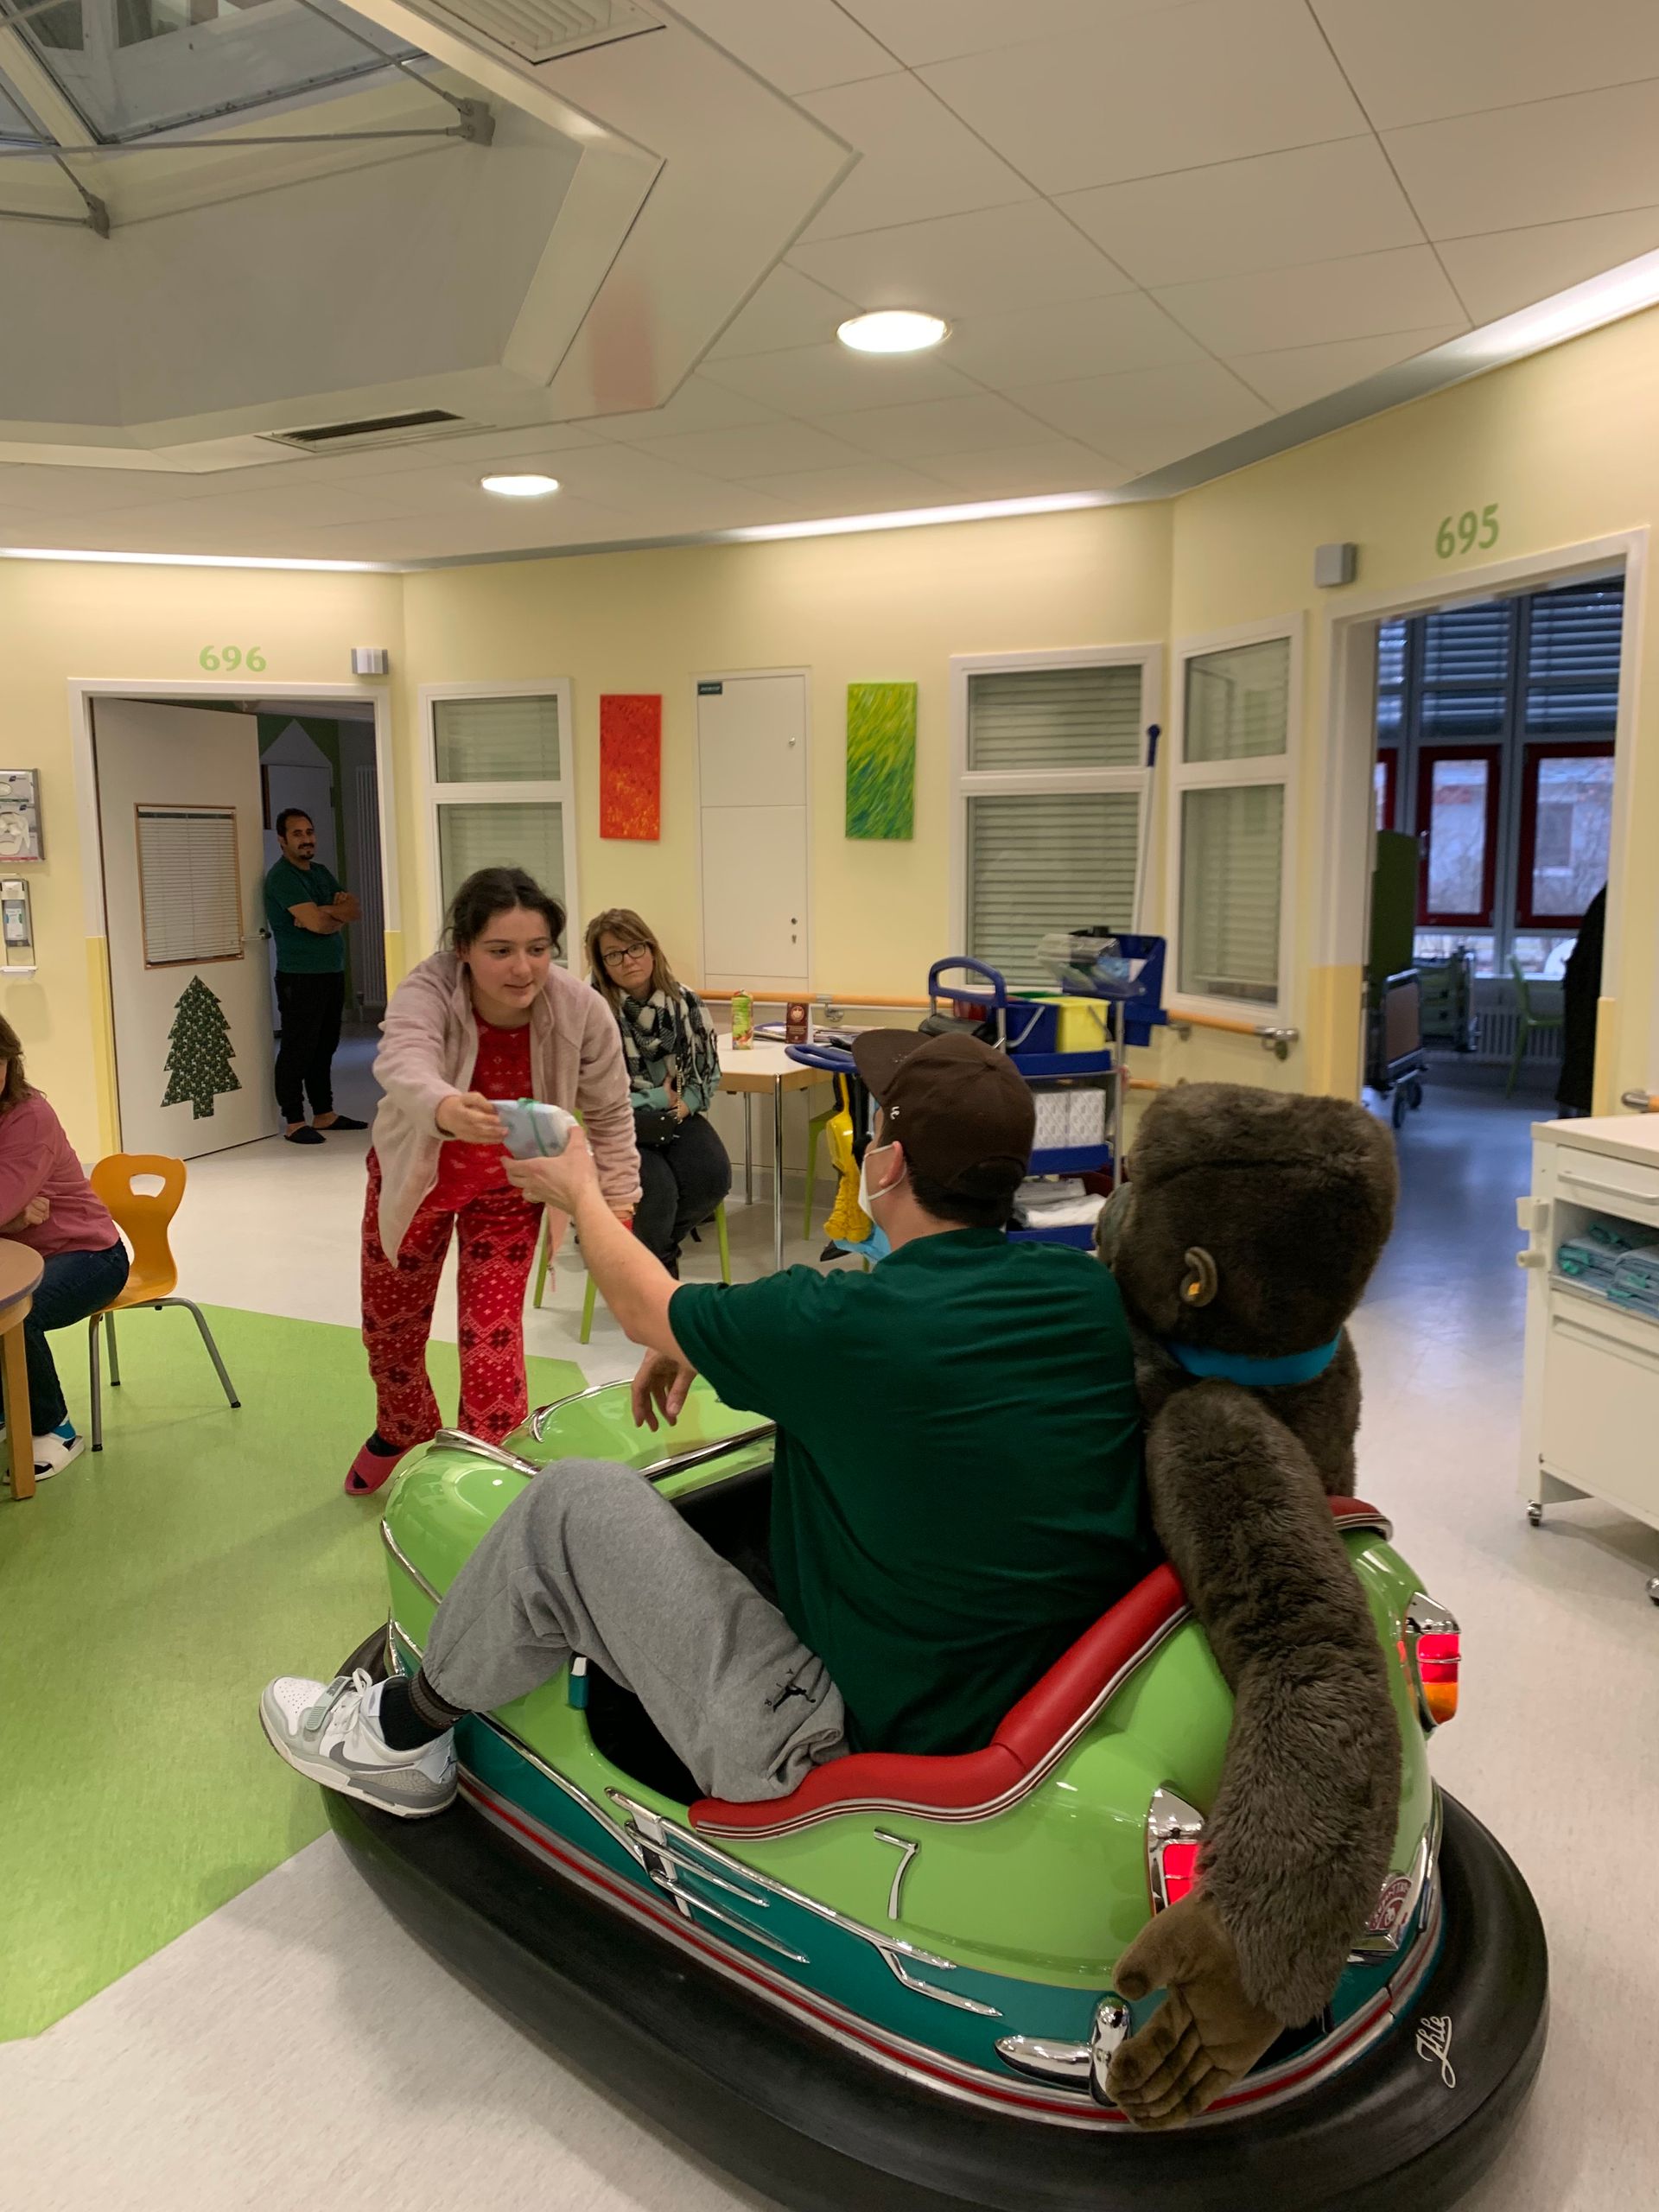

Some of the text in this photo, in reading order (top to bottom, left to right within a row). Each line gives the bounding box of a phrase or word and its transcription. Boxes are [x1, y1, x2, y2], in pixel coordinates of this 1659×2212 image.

[1436, 503, 1499, 559] 695
[199, 645, 267, 672] 696
[874, 1827, 918, 1920] 7
